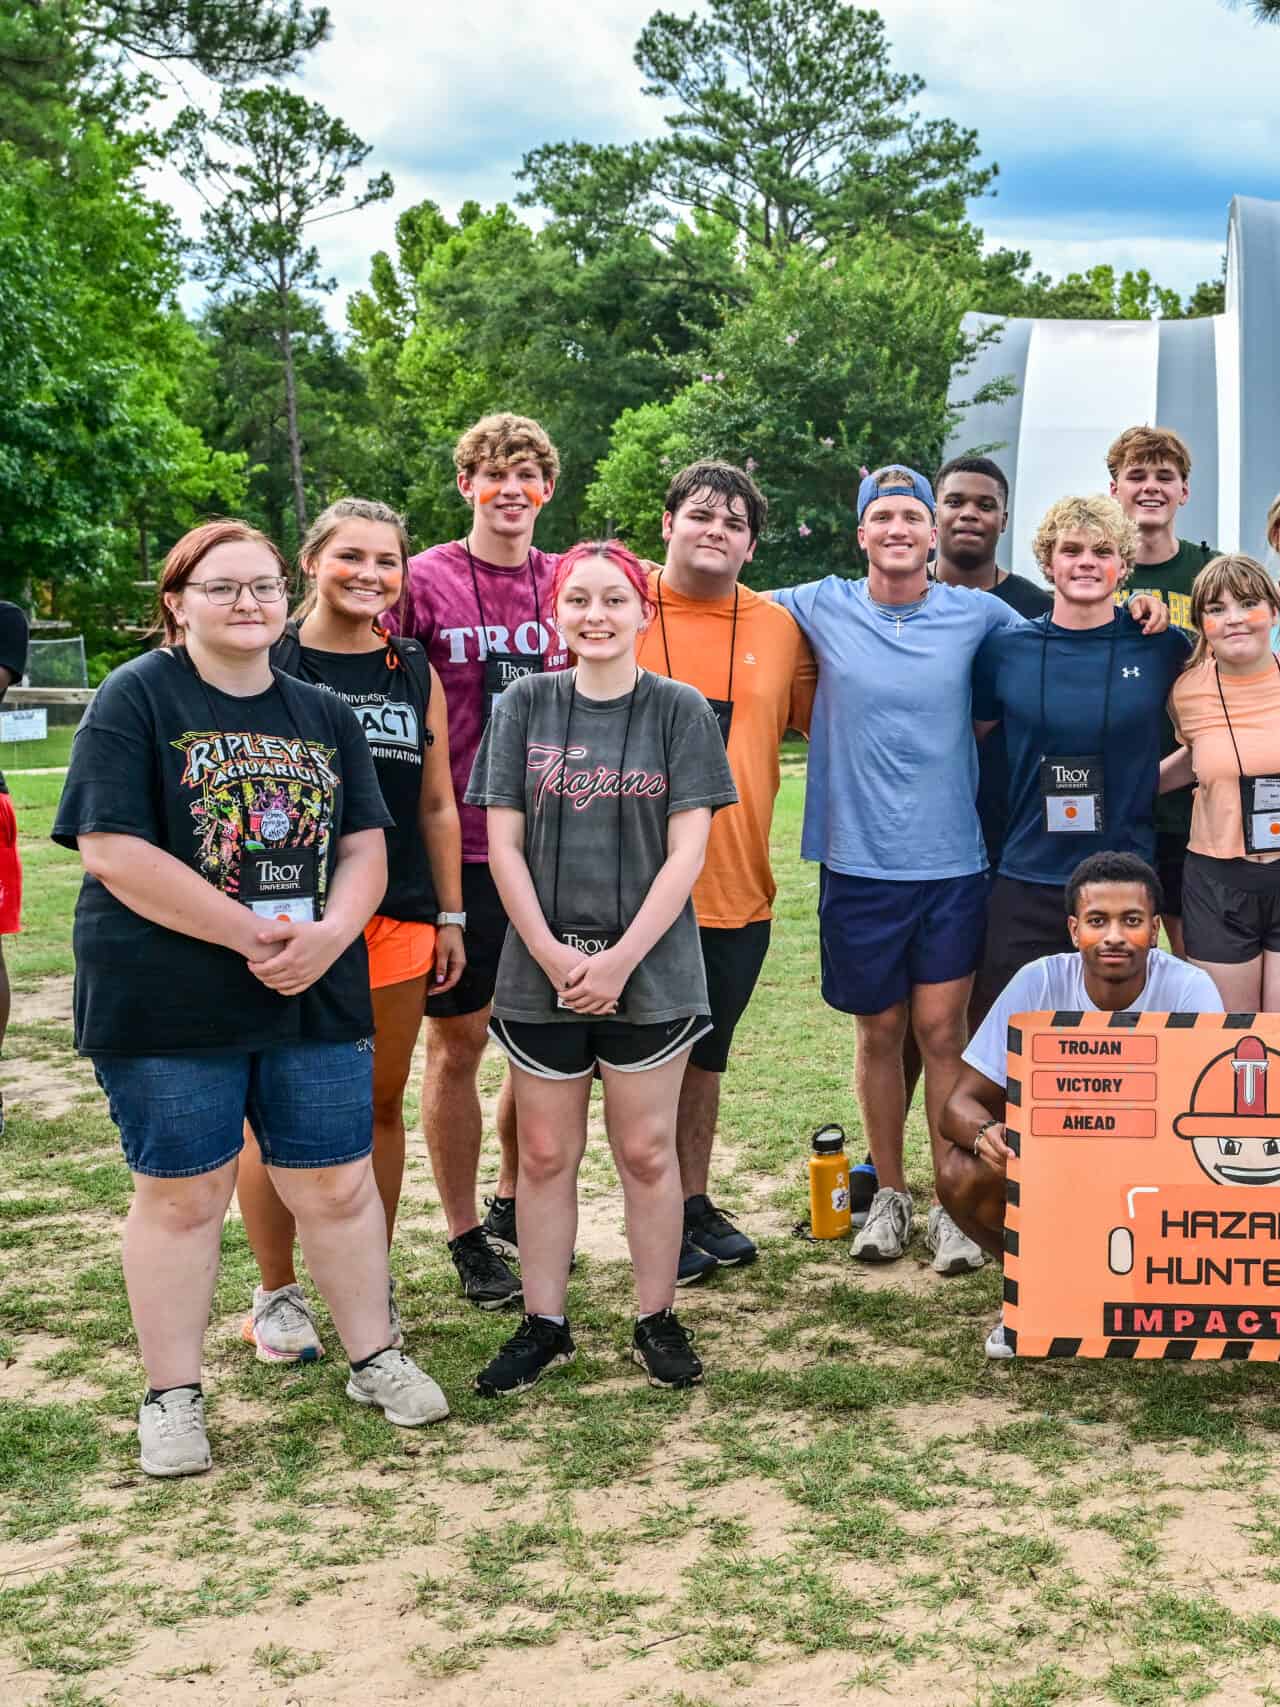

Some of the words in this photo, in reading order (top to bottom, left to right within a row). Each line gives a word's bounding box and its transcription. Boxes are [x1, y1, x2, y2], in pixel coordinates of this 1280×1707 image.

[361, 707, 409, 738] ACT
[189, 735, 337, 785] RIPLEY'S
[527, 744, 666, 812] Trojans
[1051, 766, 1090, 782] TROY
[256, 861, 303, 882] TROY
[562, 933, 608, 954] TROY
[1058, 1040, 1122, 1055] TROJAN
[1056, 1077, 1123, 1093] VICTORY
[1062, 1115, 1116, 1131] AHEAD
